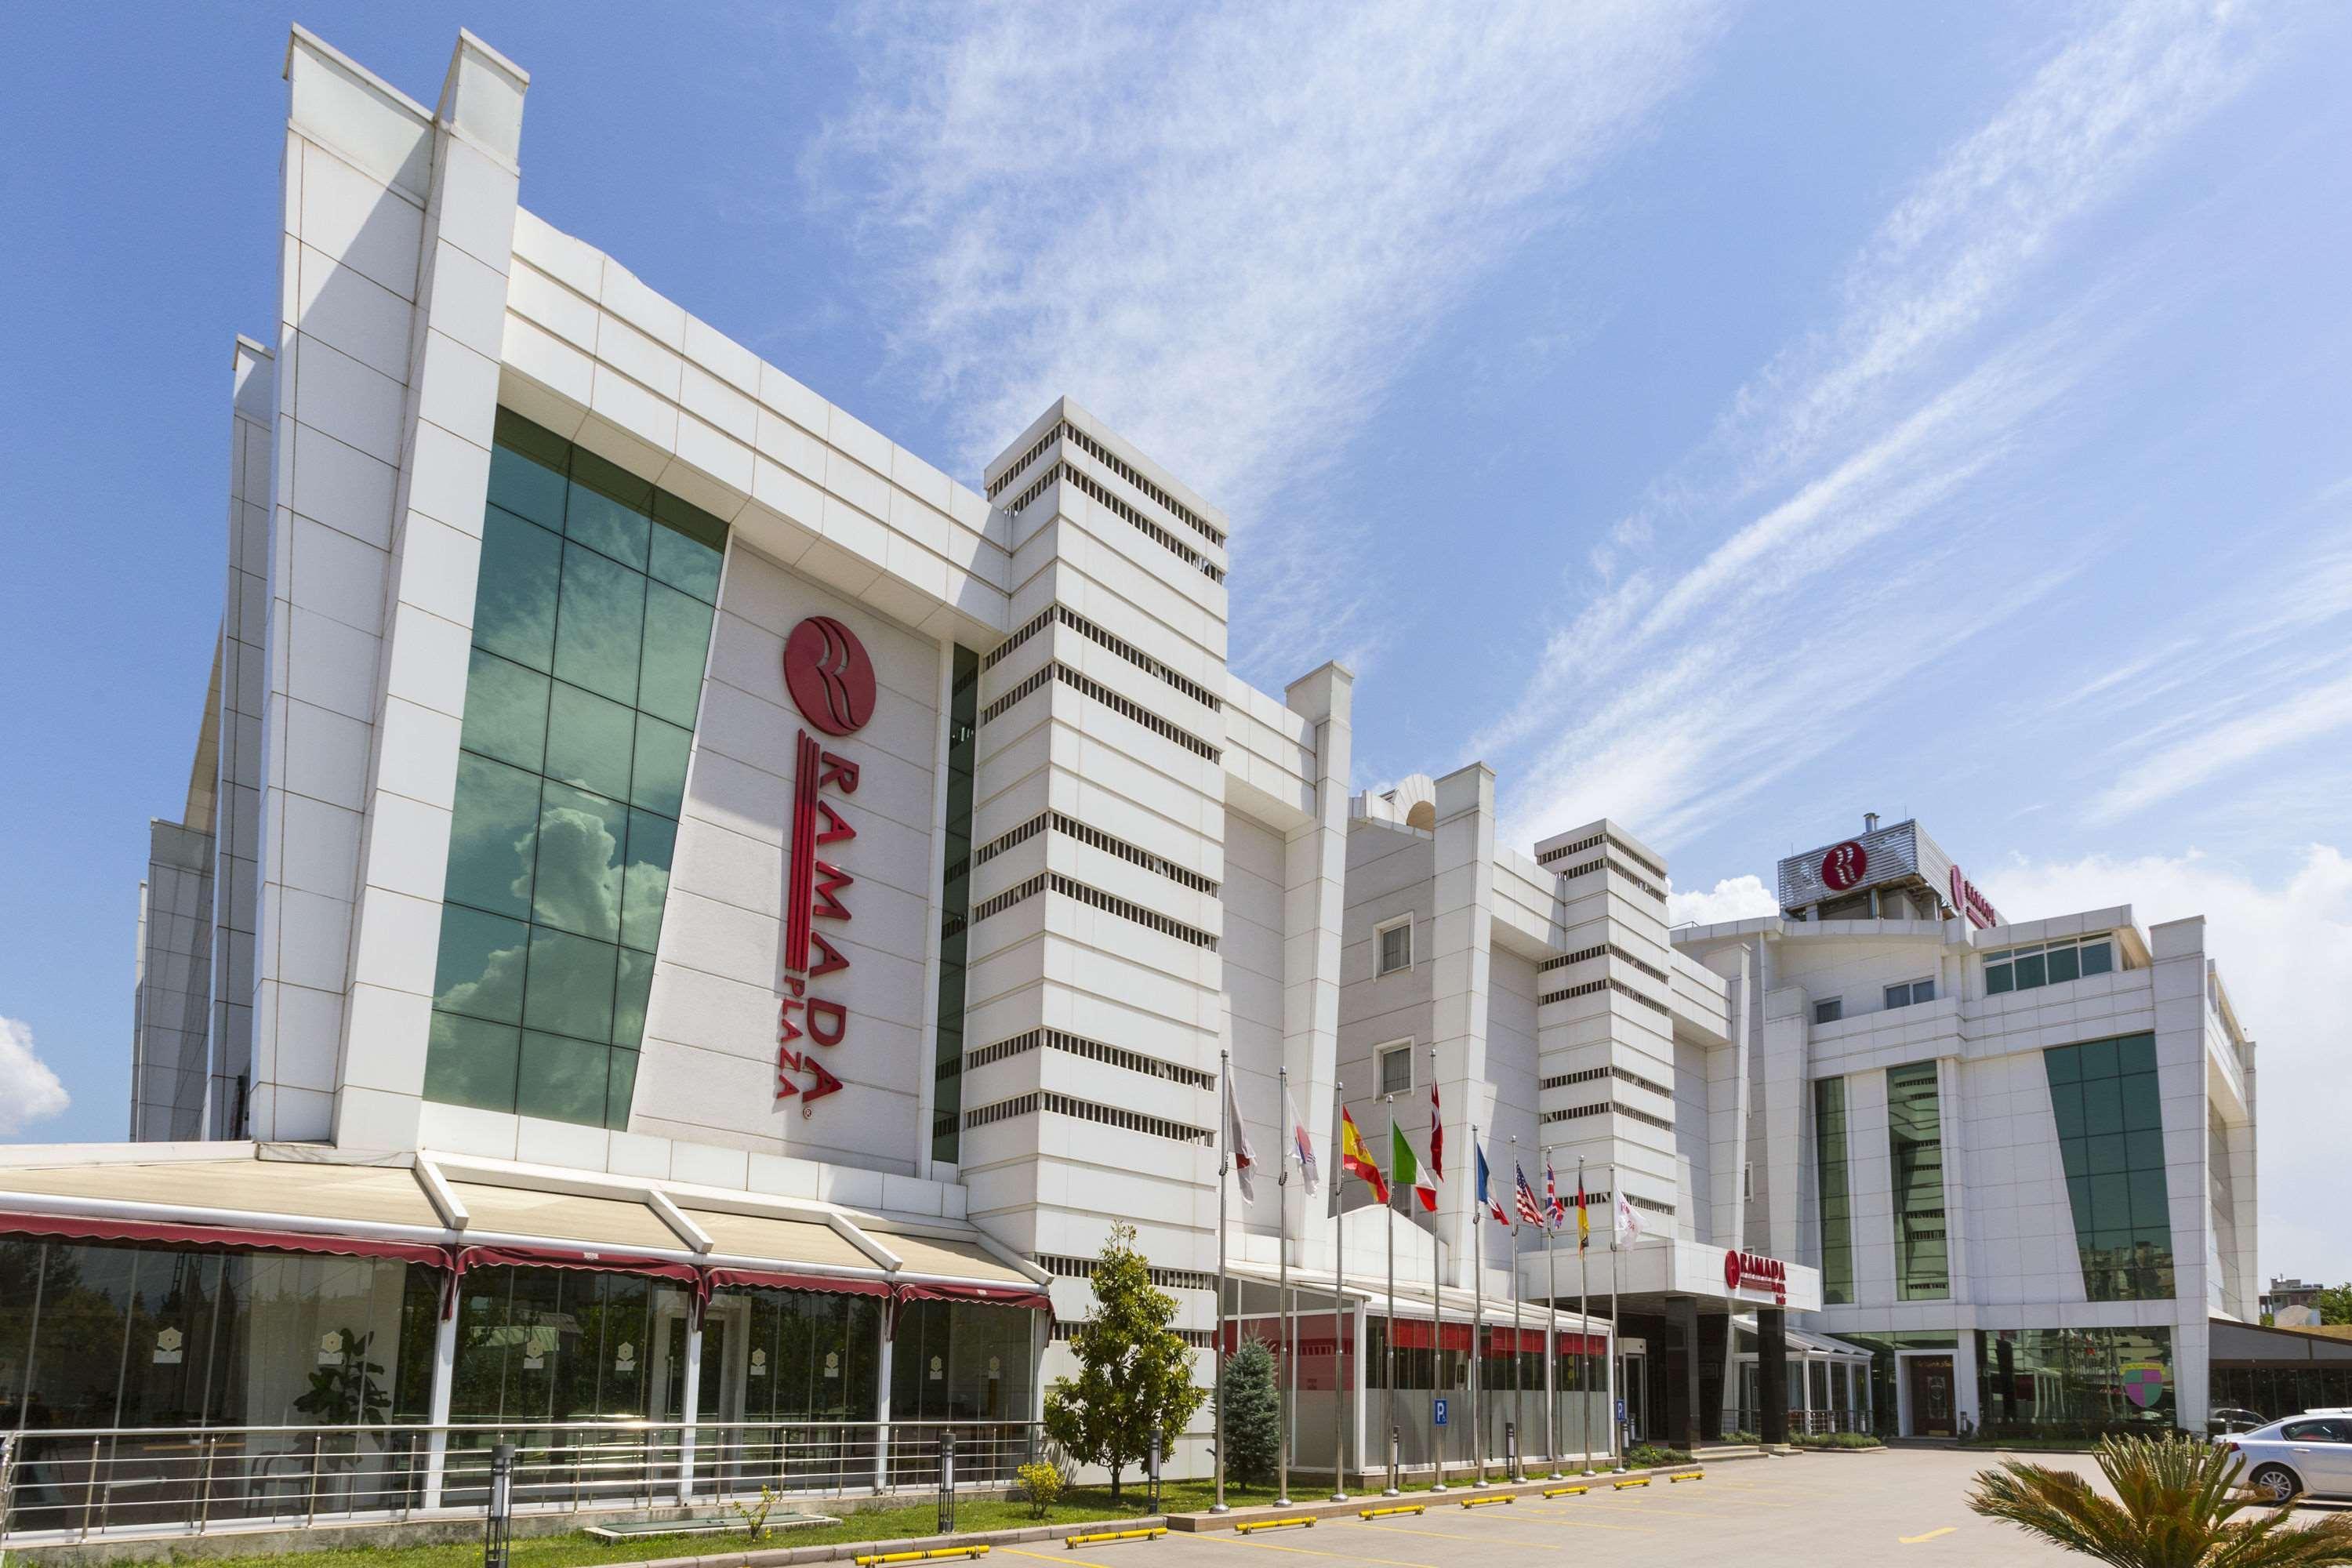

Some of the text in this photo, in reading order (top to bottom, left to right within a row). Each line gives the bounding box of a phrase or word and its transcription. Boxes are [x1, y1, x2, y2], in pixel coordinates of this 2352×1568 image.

[802, 750, 860, 1103] RAMADA
[776, 975, 805, 1099] PLAZA
[1740, 1253, 1786, 1281] RAMADA
[1437, 1403, 1444, 1422] P
